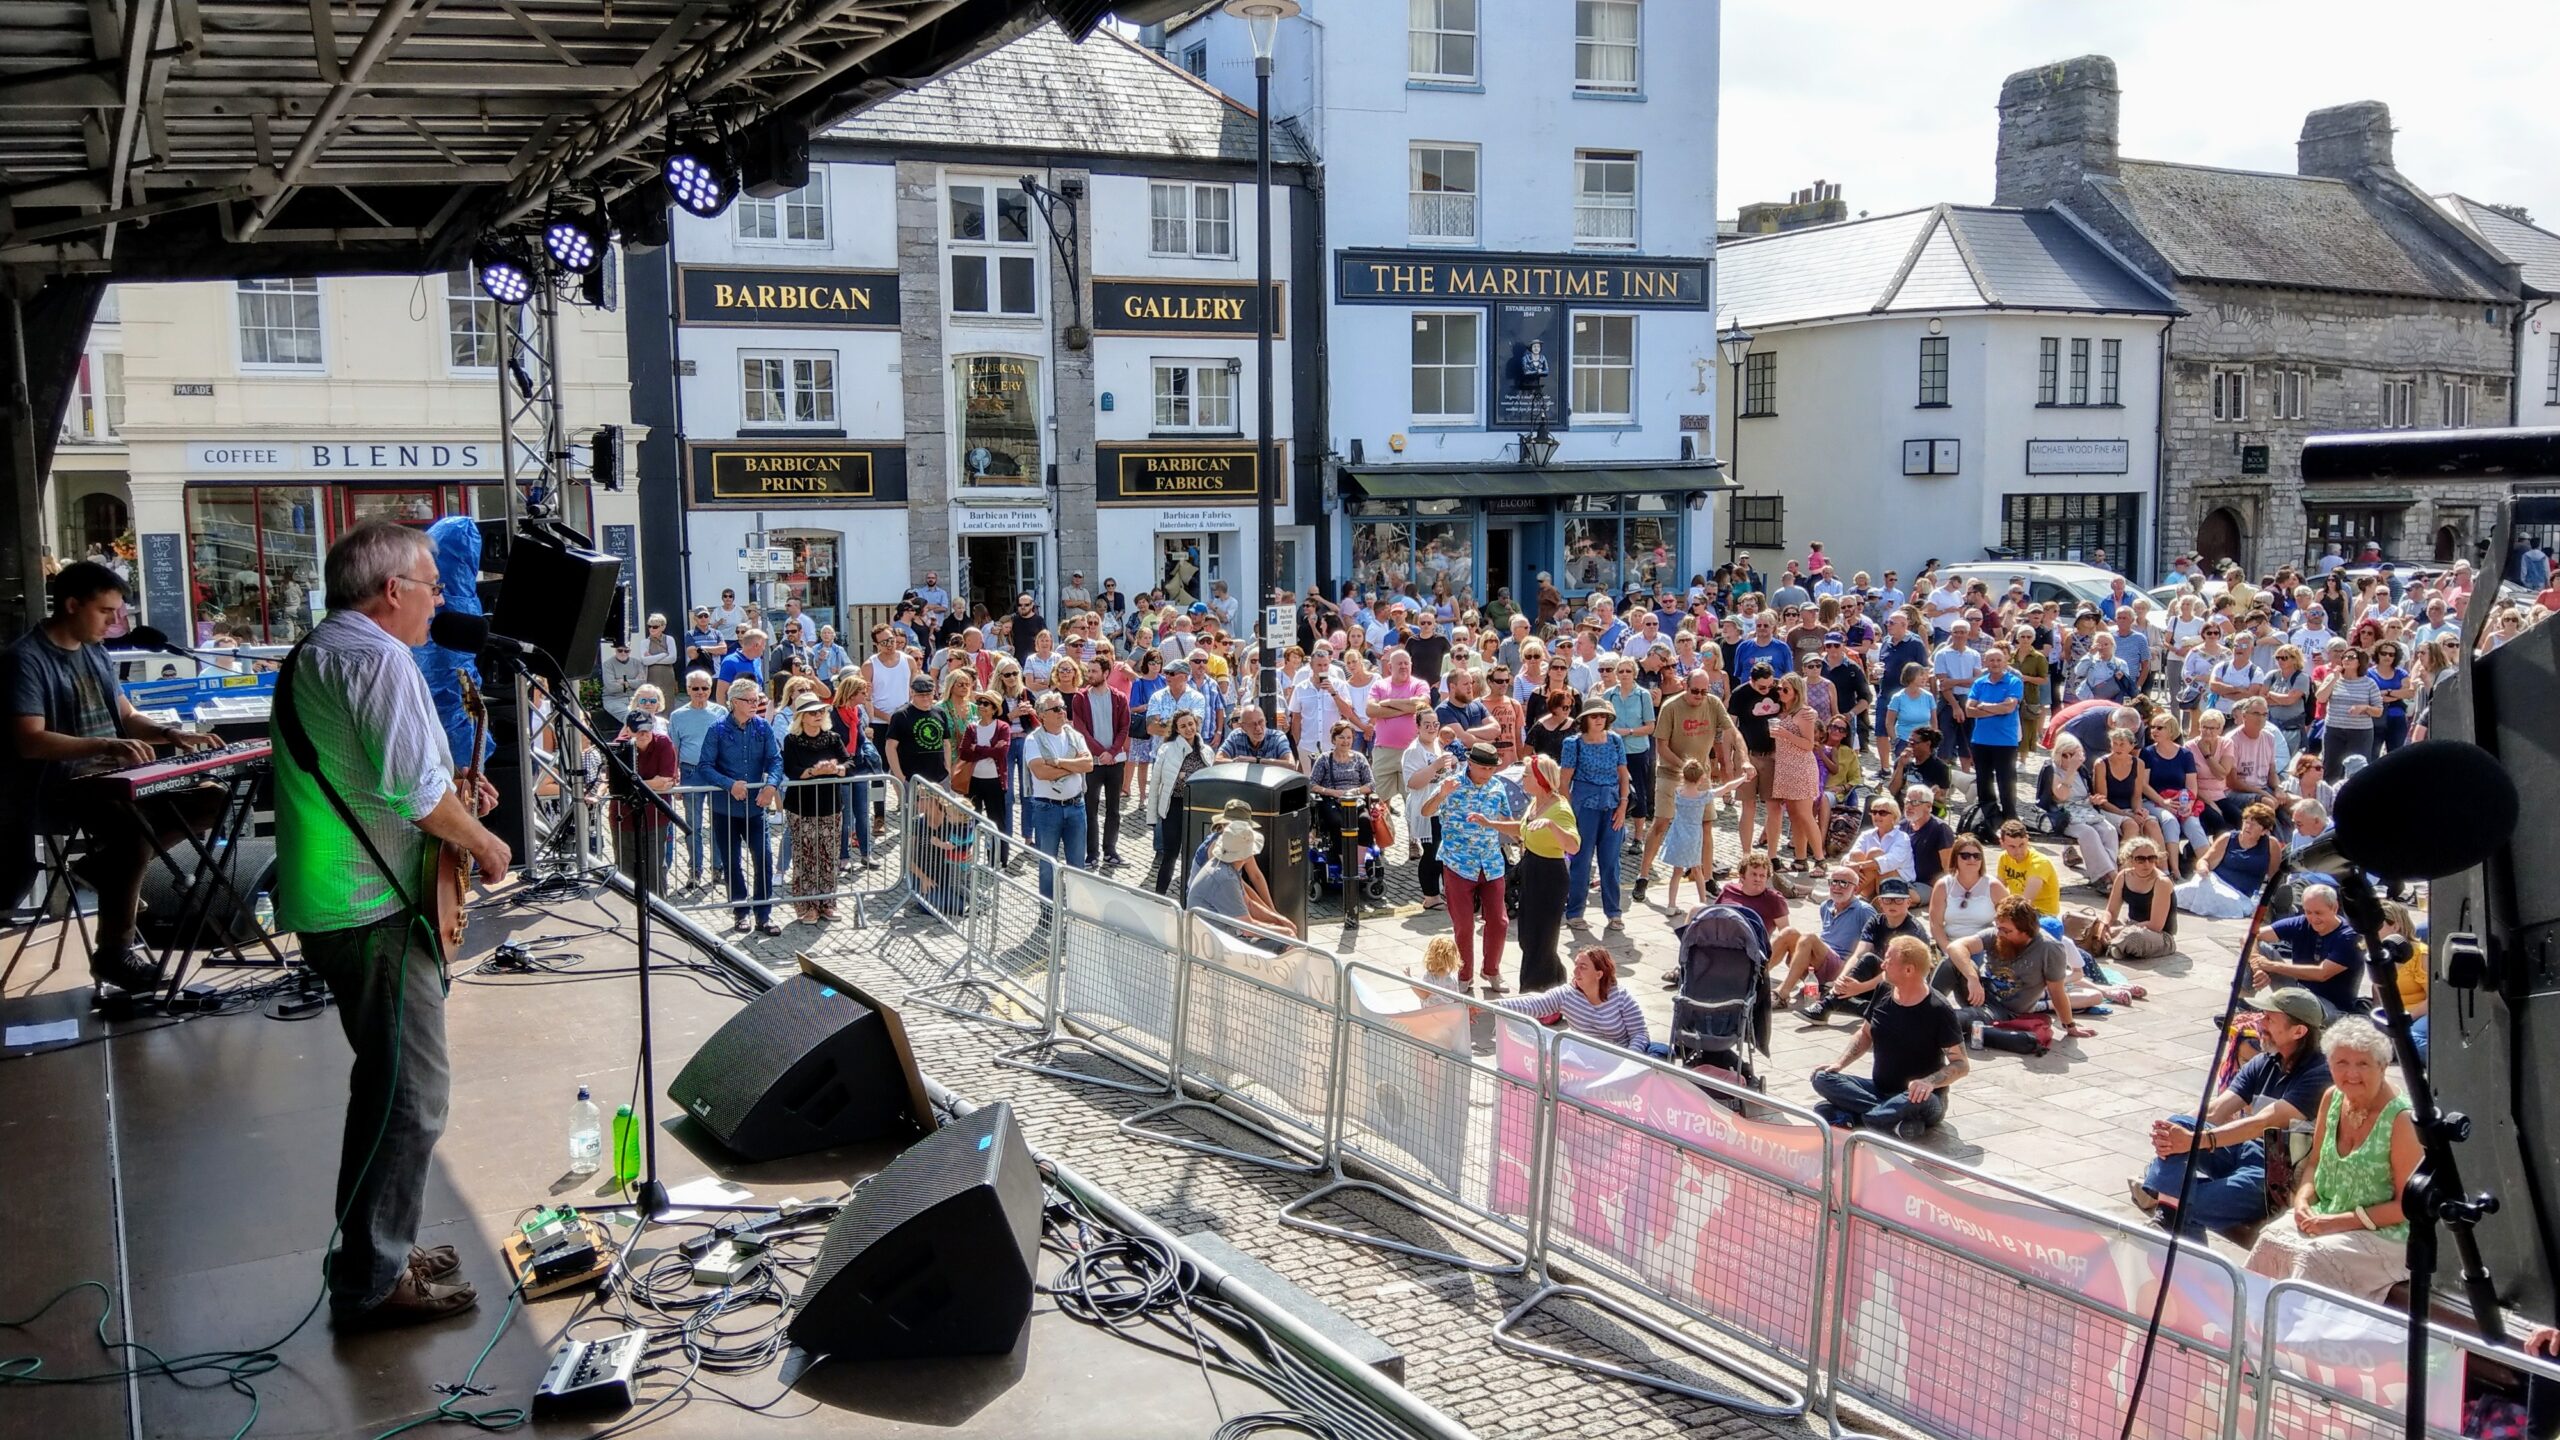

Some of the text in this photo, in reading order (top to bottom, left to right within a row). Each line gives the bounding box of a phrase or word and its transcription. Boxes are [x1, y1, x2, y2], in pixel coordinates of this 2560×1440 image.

[1370, 265, 1679, 298] THE MARITIME INN
[714, 284, 870, 310] BARBICAN
[1124, 295, 1246, 320] GALLERY
[969, 363, 1025, 375] BARBICAN
[176, 385, 211, 395] PARADE
[970, 380, 1022, 392] GALLERY
[2031, 444, 2125, 454] MICHAEL WOOD FINE ART
[204, 450, 278, 463] COFFEE
[312, 446, 478, 467] BLENDS
[744, 457, 841, 472] BARBICAN
[1147, 458, 1231, 472] BARBICAN
[760, 477, 827, 491] PRINTS
[1155, 476, 1224, 490] FABRICS
[970, 511, 1006, 520] Barbican
[1163, 511, 1232, 520] Barbican Fabrics
[136, 784, 154, 797] nord
[155, 779, 180, 792] electro
